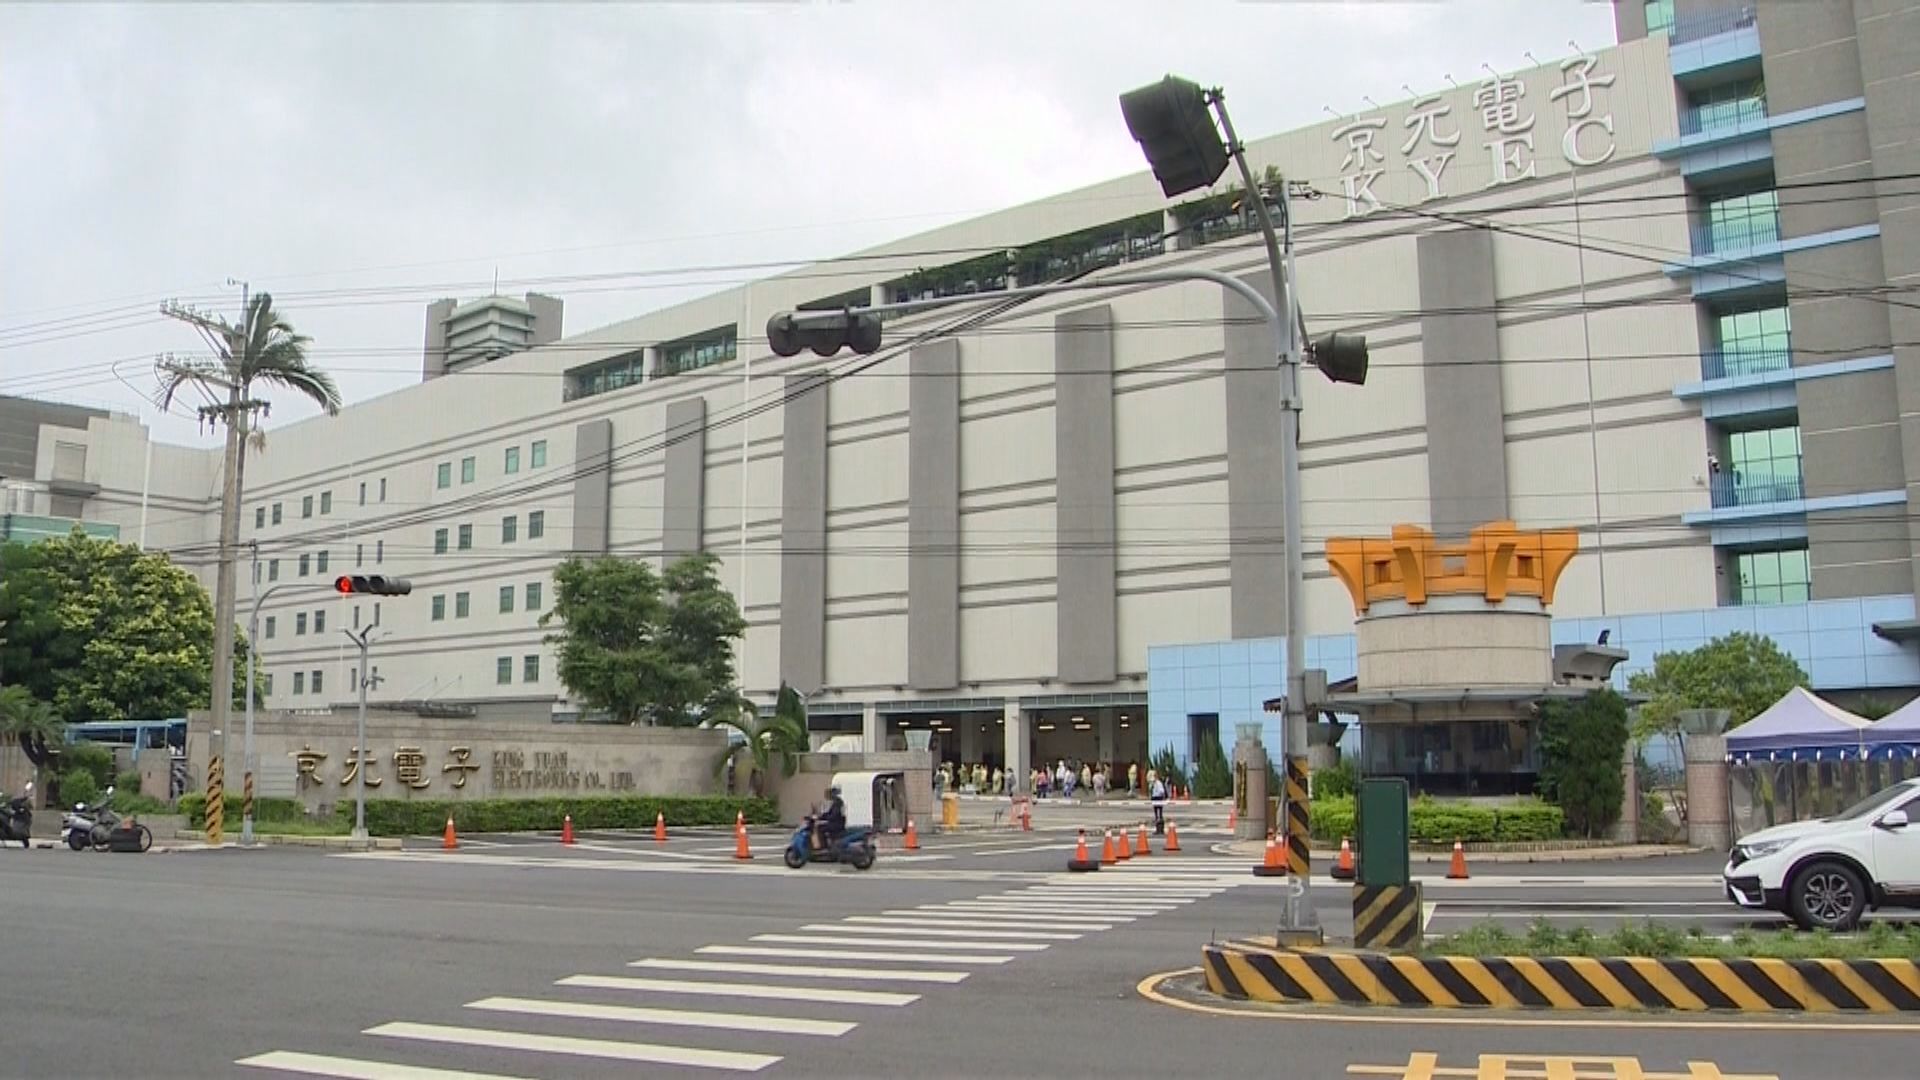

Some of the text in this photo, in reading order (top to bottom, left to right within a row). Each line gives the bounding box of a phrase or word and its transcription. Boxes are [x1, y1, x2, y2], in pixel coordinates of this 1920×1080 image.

[1331, 54, 1616, 170] 京元電子
[1340, 116, 1616, 220] KYEC
[288, 744, 480, 788] 京元電子
[493, 751, 568, 768] KING YUAN
[493, 769, 580, 789] ELECTRONICS
